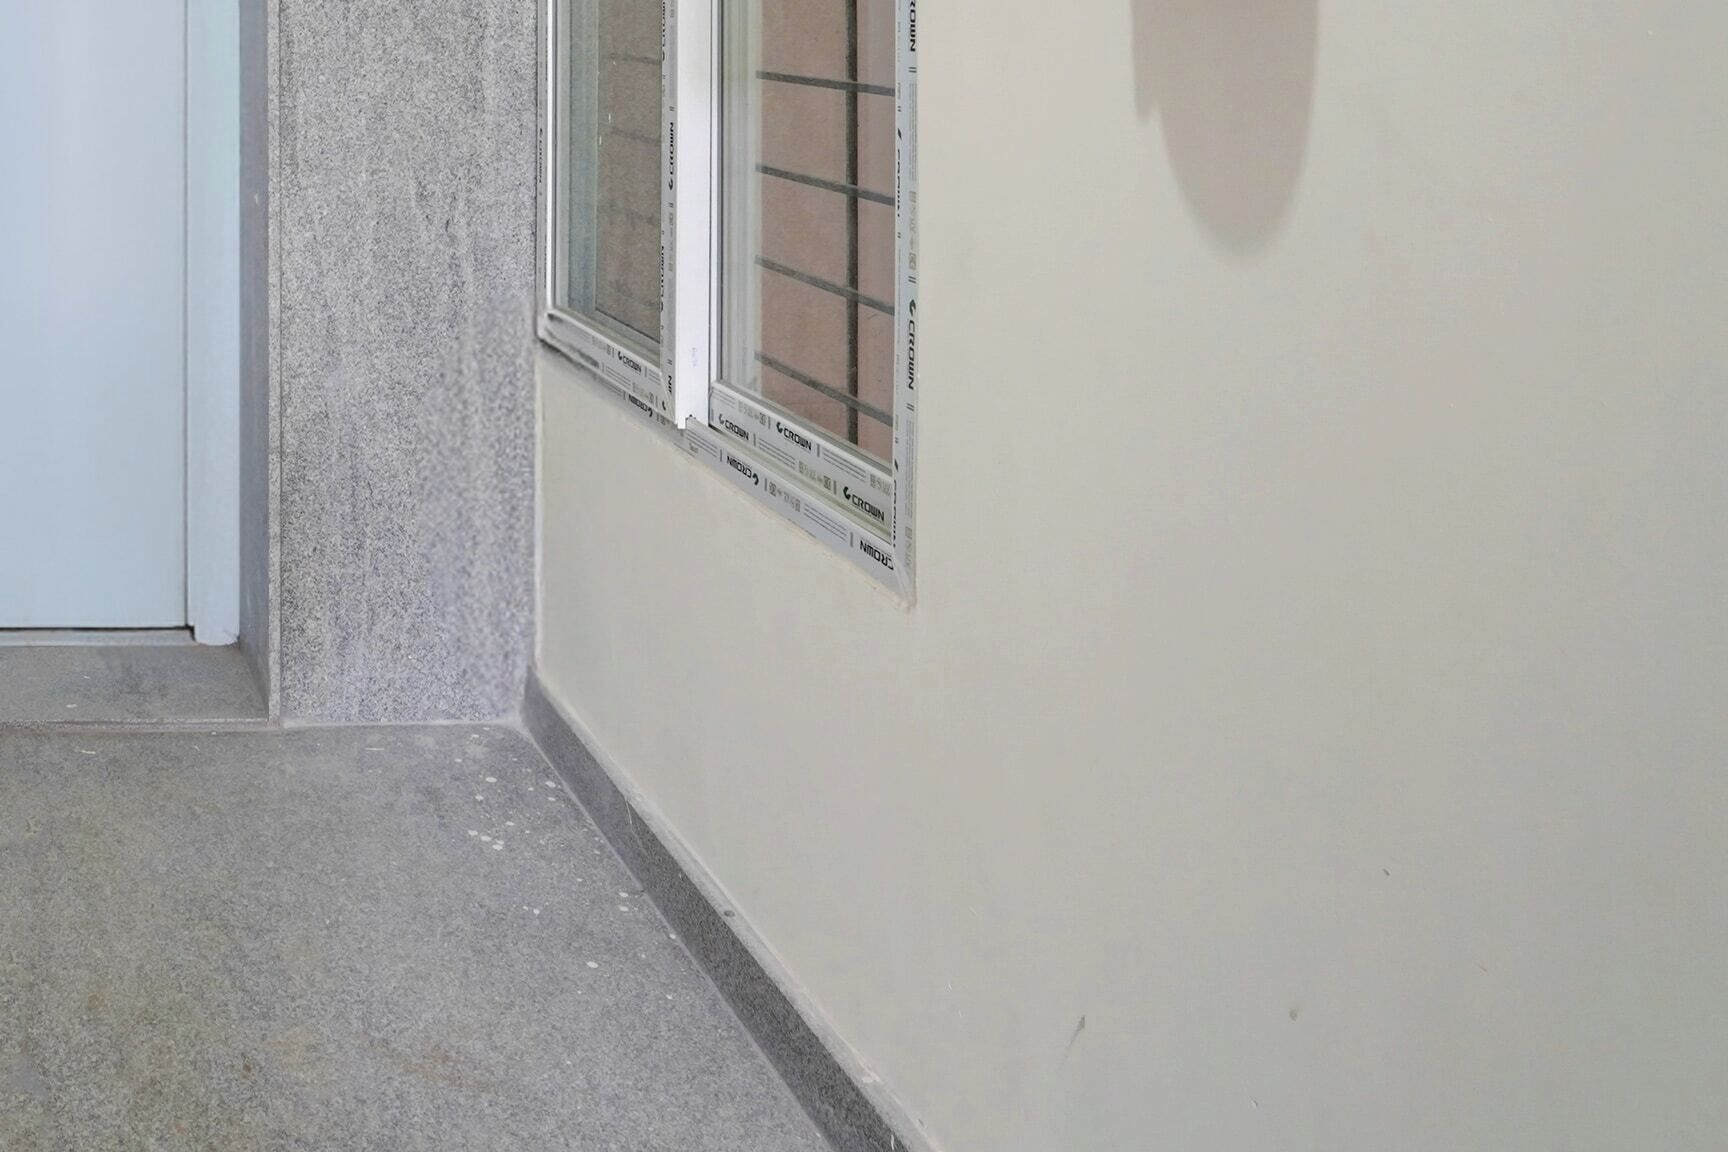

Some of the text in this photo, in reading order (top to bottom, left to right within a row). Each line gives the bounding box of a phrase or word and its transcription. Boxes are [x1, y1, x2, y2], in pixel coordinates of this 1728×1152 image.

[907, 320, 915, 390] CROWN
[725, 420, 749, 441] CROWN
[783, 428, 812, 451] CROWN
[727, 455, 752, 478] CROWN
[852, 494, 885, 522] CROWN
[859, 540, 894, 570] CROWN
